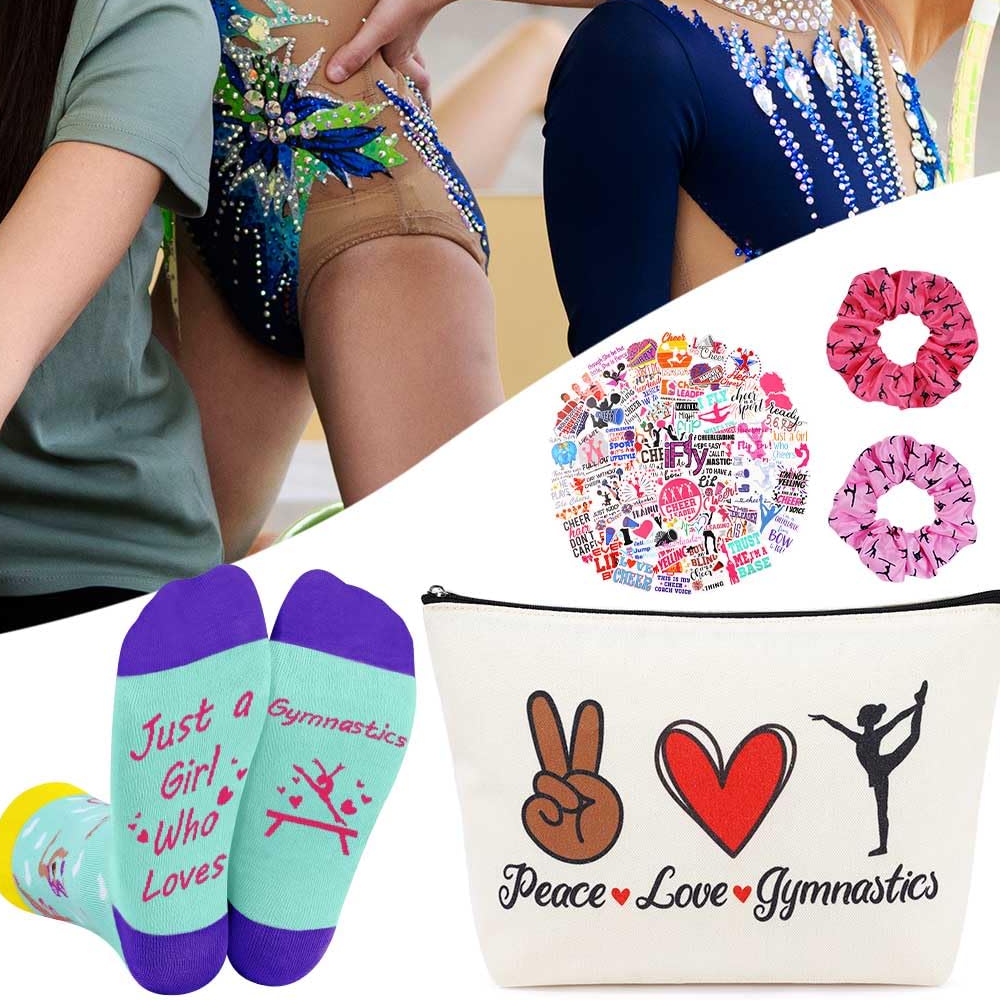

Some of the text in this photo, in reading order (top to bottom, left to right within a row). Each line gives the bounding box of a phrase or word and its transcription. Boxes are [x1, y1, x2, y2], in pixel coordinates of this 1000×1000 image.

[662, 332, 686, 343] Cheer
[675, 402, 699, 411] WARNIN
[706, 390, 728, 406] FLY
[766, 401, 800, 428] ready
[610, 441, 634, 450] SPORT
[665, 498, 697, 514] CHEER
[563, 513, 591, 531] CHEER
[569, 530, 594, 549] DON'T
[727, 531, 760, 554] TRUST
[768, 529, 794, 549] BOW
[737, 556, 772, 579] BASE
[612, 568, 653, 592] CHEER
[130, 690, 254, 761] Just a
[267, 697, 408, 748] Gymnastics
[160, 744, 221, 801] Girl
[153, 809, 219, 856] Who
[142, 853, 228, 902] Loves
[498, 862, 939, 922] Peace Love Gymnastics
